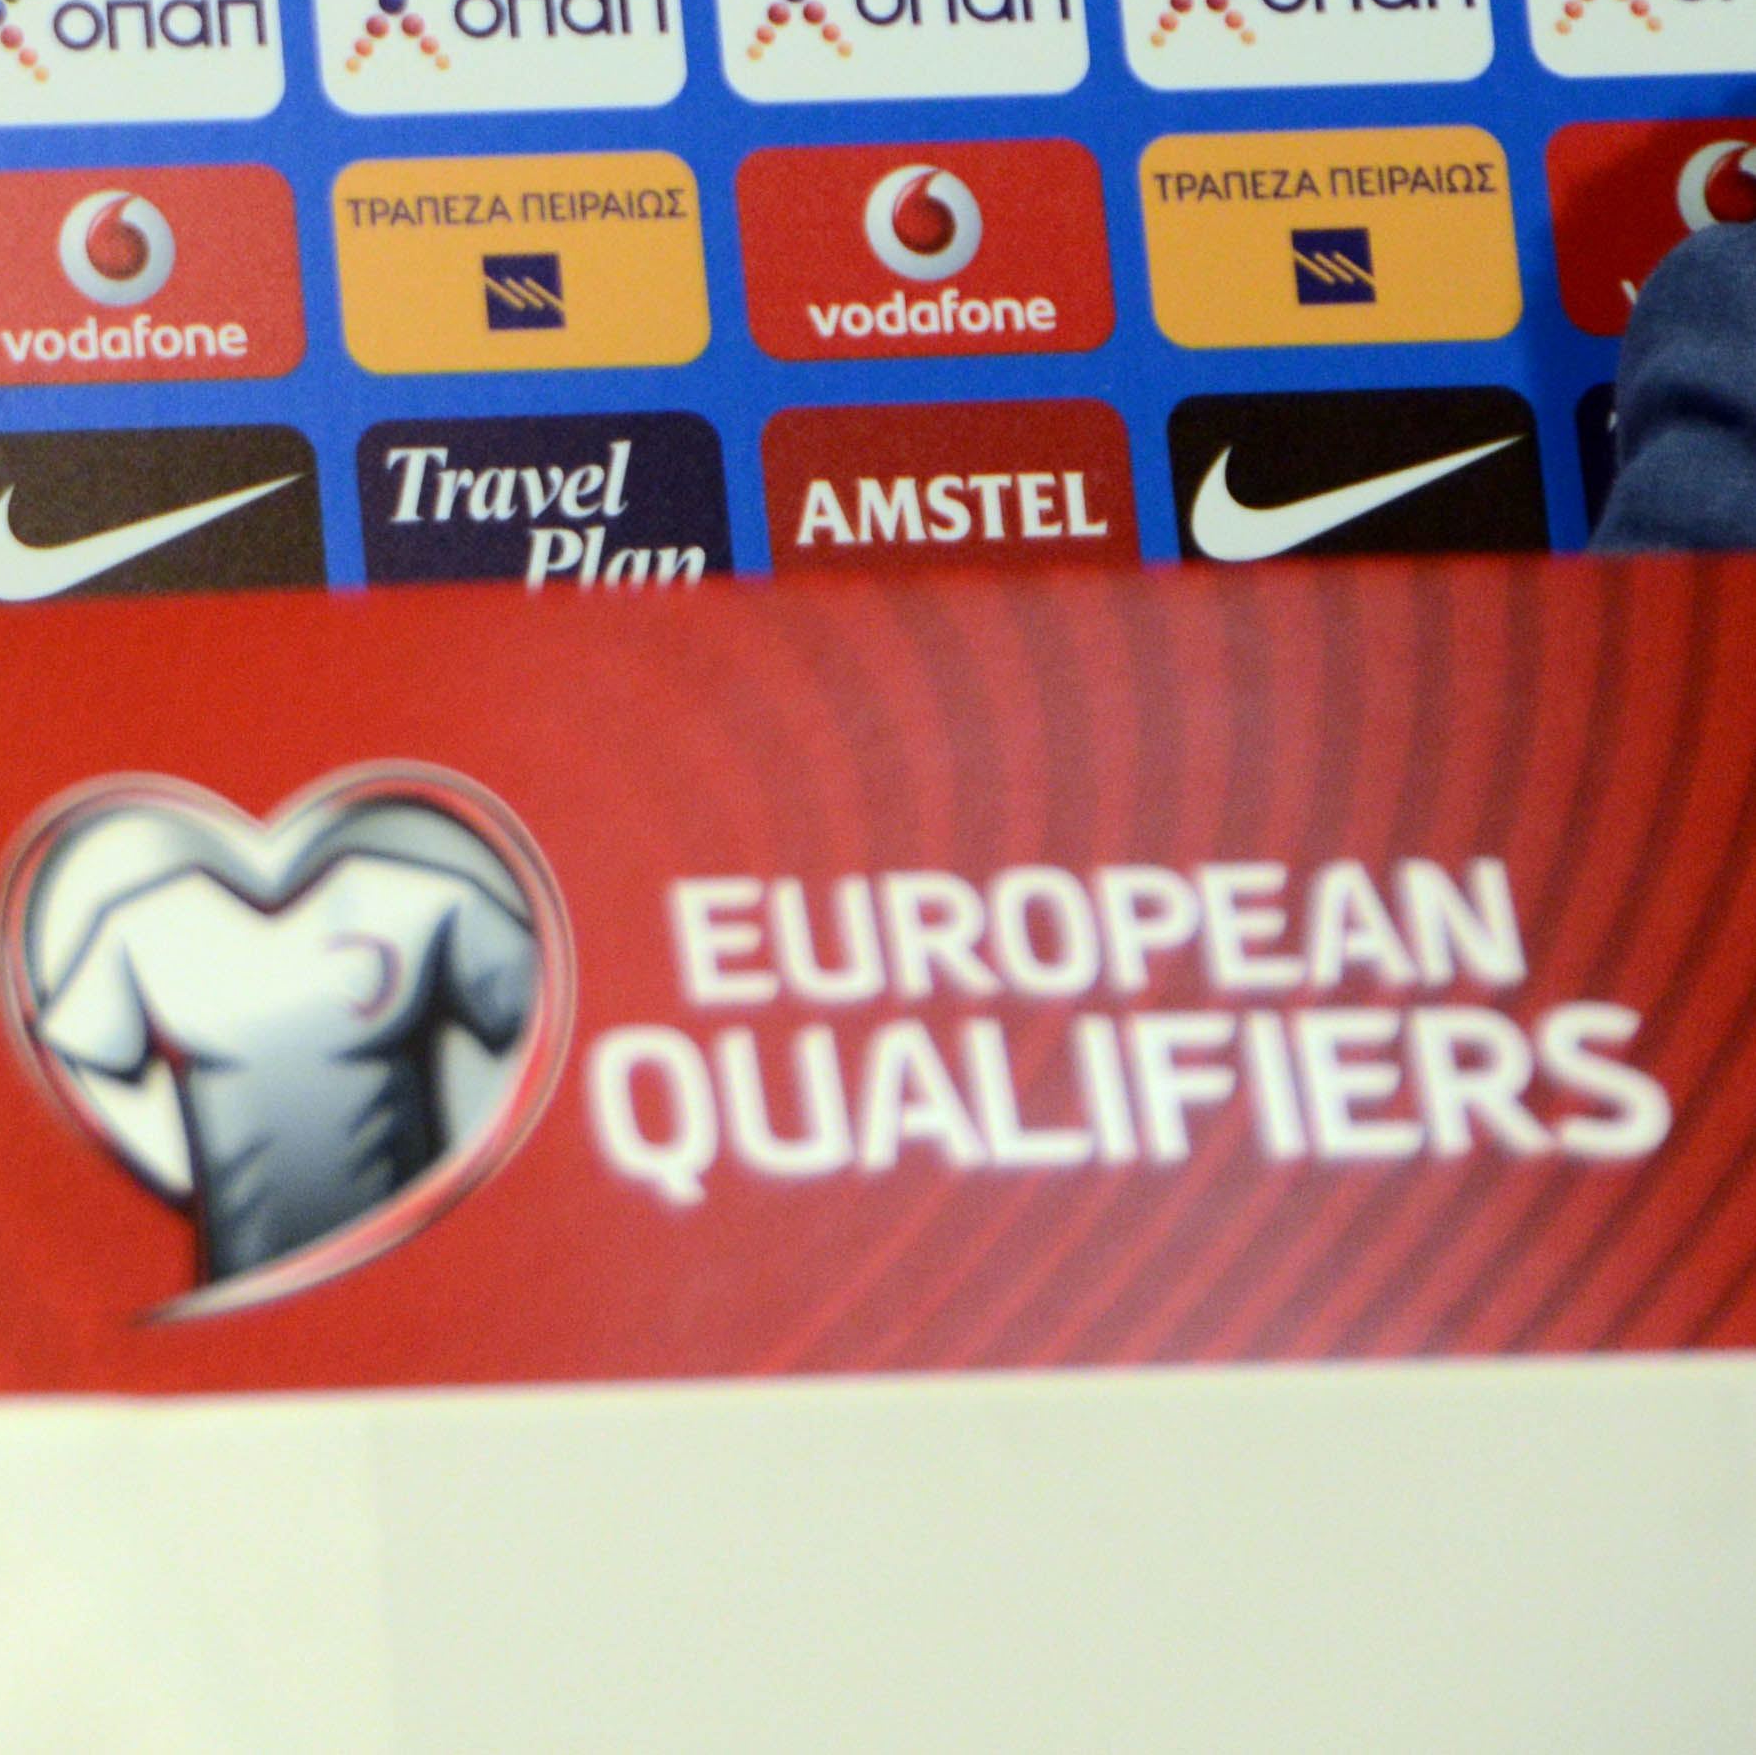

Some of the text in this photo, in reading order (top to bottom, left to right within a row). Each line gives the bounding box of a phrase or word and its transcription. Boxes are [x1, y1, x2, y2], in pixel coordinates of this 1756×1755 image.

[346, 187, 688, 228] ΤΡΑΠΕΖΑ ΠΕΙΡΑΙΩΣ
[1153, 162, 1499, 203] ΤΡΑΠΕΖΑ ΠΕΙΡΑΙΩΣ
[0, 314, 249, 363] vodafone
[807, 287, 1057, 338] vodafone
[384, 439, 632, 523] Travel
[796, 471, 1108, 545] AMSTEL
[526, 524, 706, 594] Plan
[667, 855, 1524, 1012] EUROPEAN
[584, 996, 1672, 1204] QUALIFIERS
